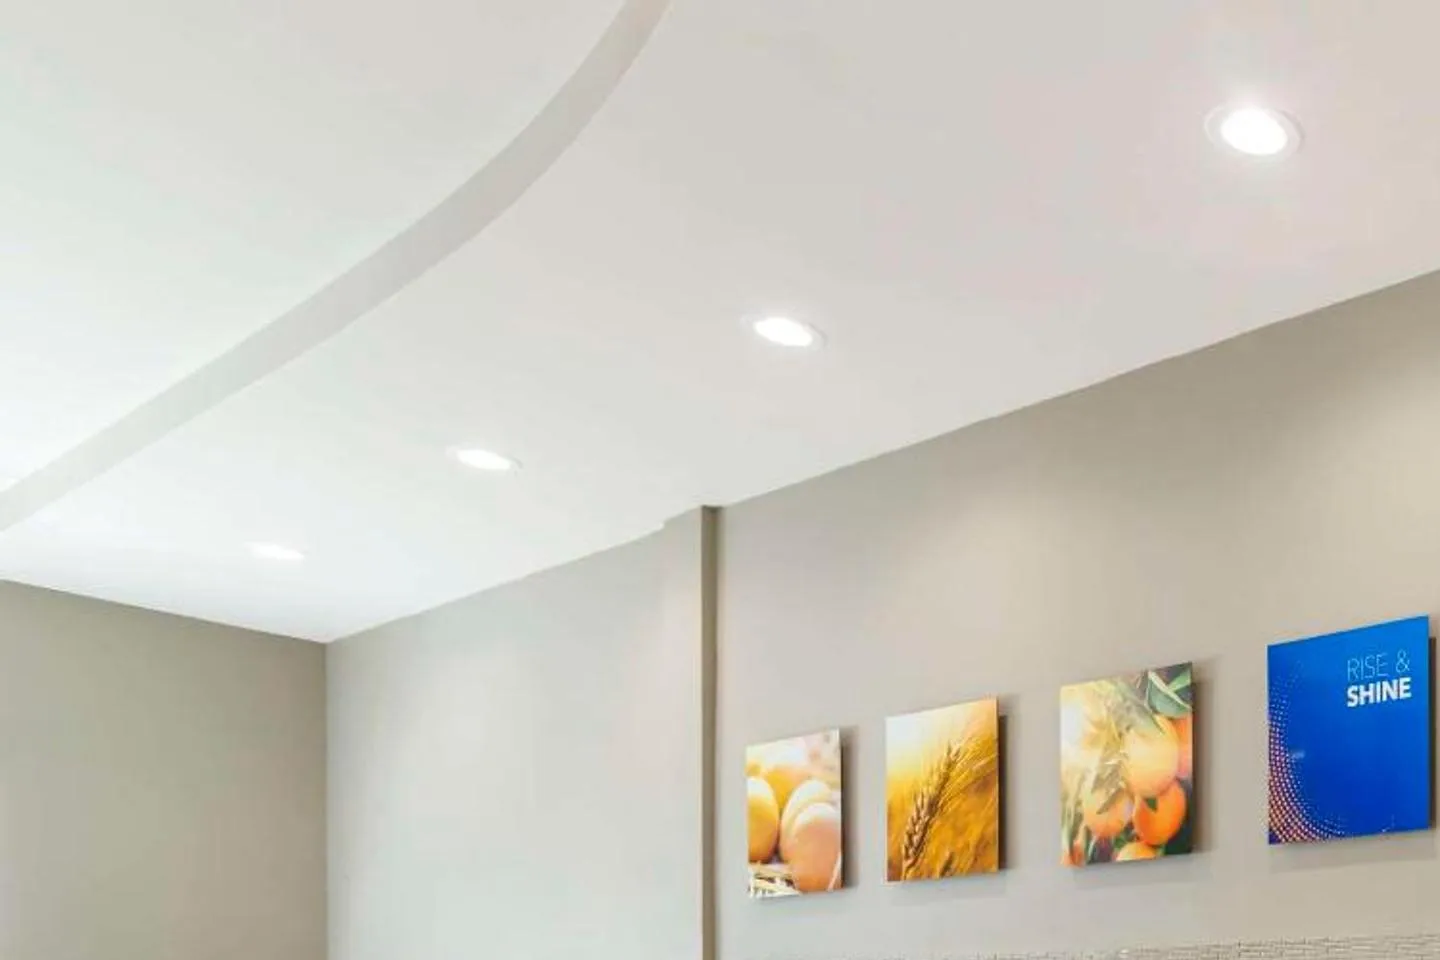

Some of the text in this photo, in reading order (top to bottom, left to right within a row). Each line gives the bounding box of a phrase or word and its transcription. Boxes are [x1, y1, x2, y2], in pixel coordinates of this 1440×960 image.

[1347, 649, 1410, 681] RISE &
[1347, 677, 1412, 708] SHINE
